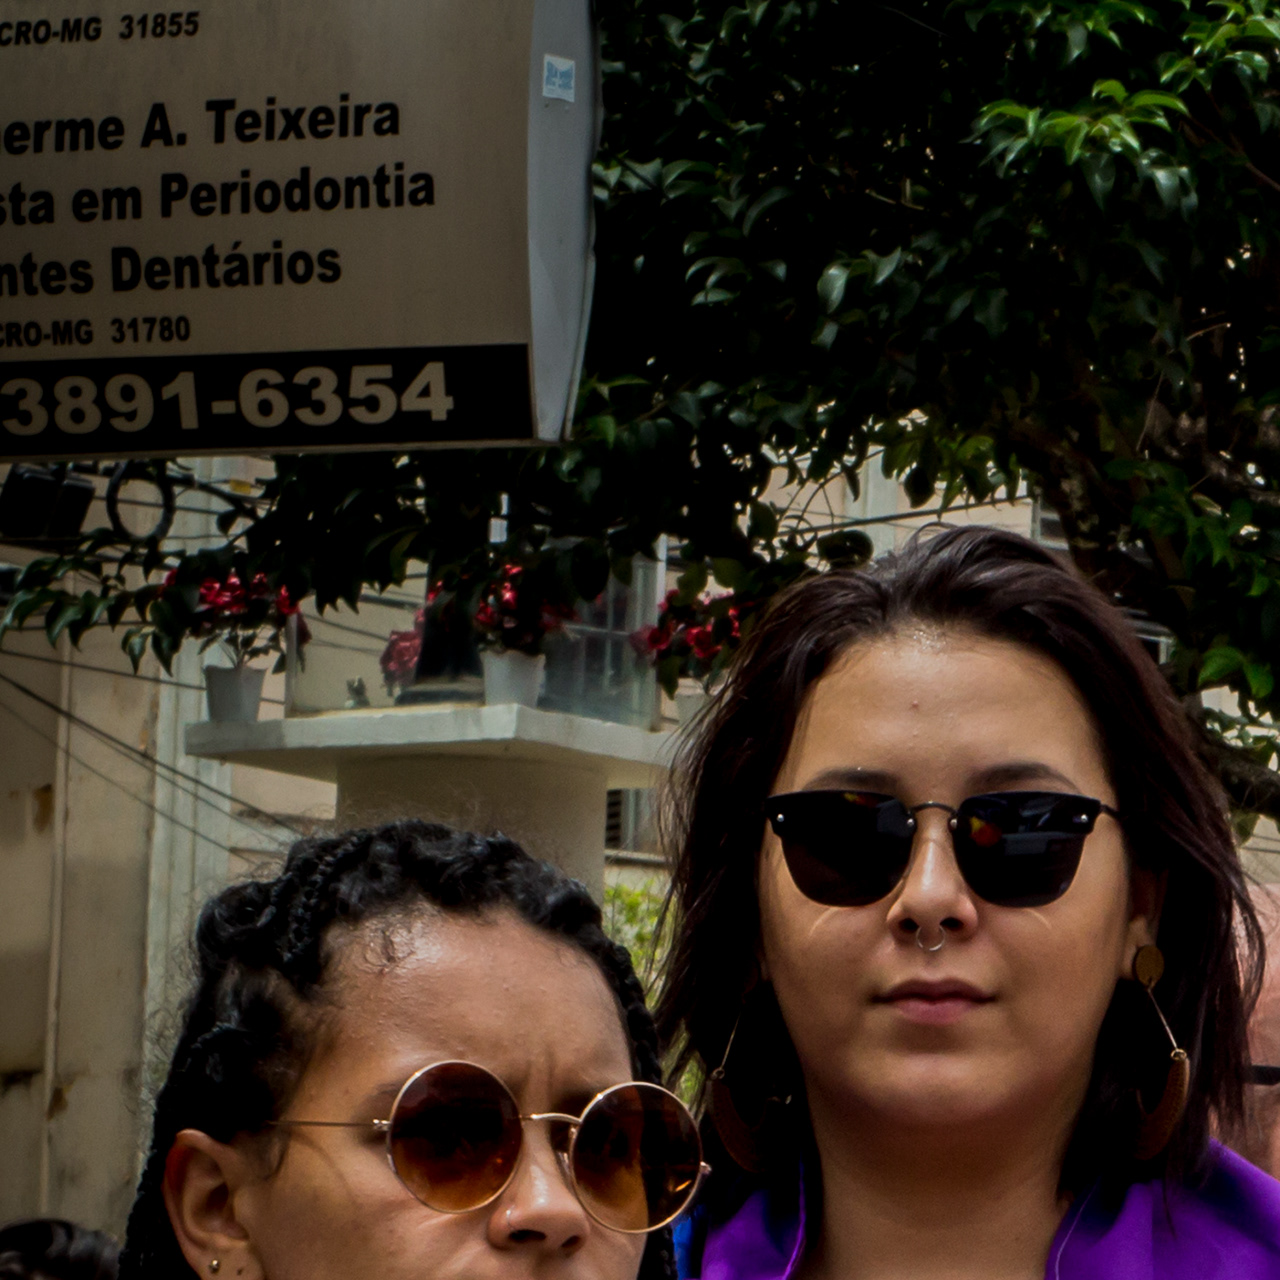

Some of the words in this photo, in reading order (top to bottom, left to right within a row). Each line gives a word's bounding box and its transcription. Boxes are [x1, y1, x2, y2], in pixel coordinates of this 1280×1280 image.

[119, 12, 200, 40] 31855
[3, 114, 125, 155] erme
[140, 103, 188, 149] A.
[205, 93, 401, 145] Teixeira
[0, 182, 55, 226] ta
[71, 185, 143, 223] em
[160, 163, 436, 219] Periodontia
[110, 240, 343, 293] Dentários
[110, 316, 191, 344] 31780
[0, 361, 455, 437] 3891-6354
